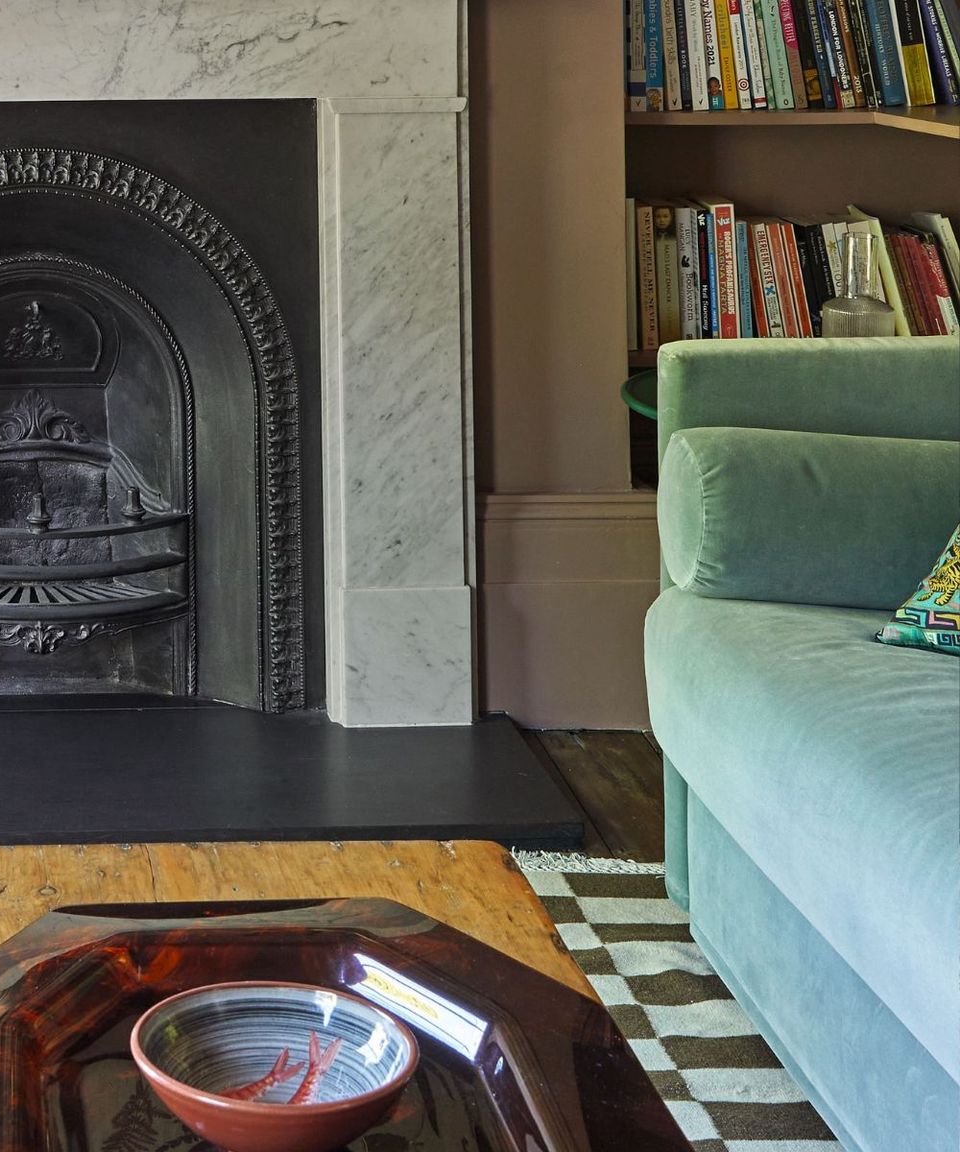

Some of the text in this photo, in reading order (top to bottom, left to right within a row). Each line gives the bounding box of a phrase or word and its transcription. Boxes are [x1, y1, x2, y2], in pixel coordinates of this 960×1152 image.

[666, 27, 675, 65] birth skills
[704, 11, 713, 44] Names
[784, 23, 796, 42] BETTER
[811, 17, 822, 53] PERCEIVED
[927, 6, 937, 25] STORIES
[936, 32, 945, 53] WORRIED
[941, 56, 952, 77] LIBERALS
[649, 37, 658, 78] Toddlers
[707, 46, 715, 66] 2021
[828, 10, 838, 36] LONDON
[836, 51, 849, 89] LONDONERS
[874, 24, 890, 86] HISTORY WORLD
[854, 75, 862, 93] 2013
[724, 231, 735, 314] ROGER'S PROFANISAURUS
[757, 230, 774, 284] EMERGENCY SEX
[647, 278, 653, 294] ME
[686, 273, 694, 321] Bookworm
